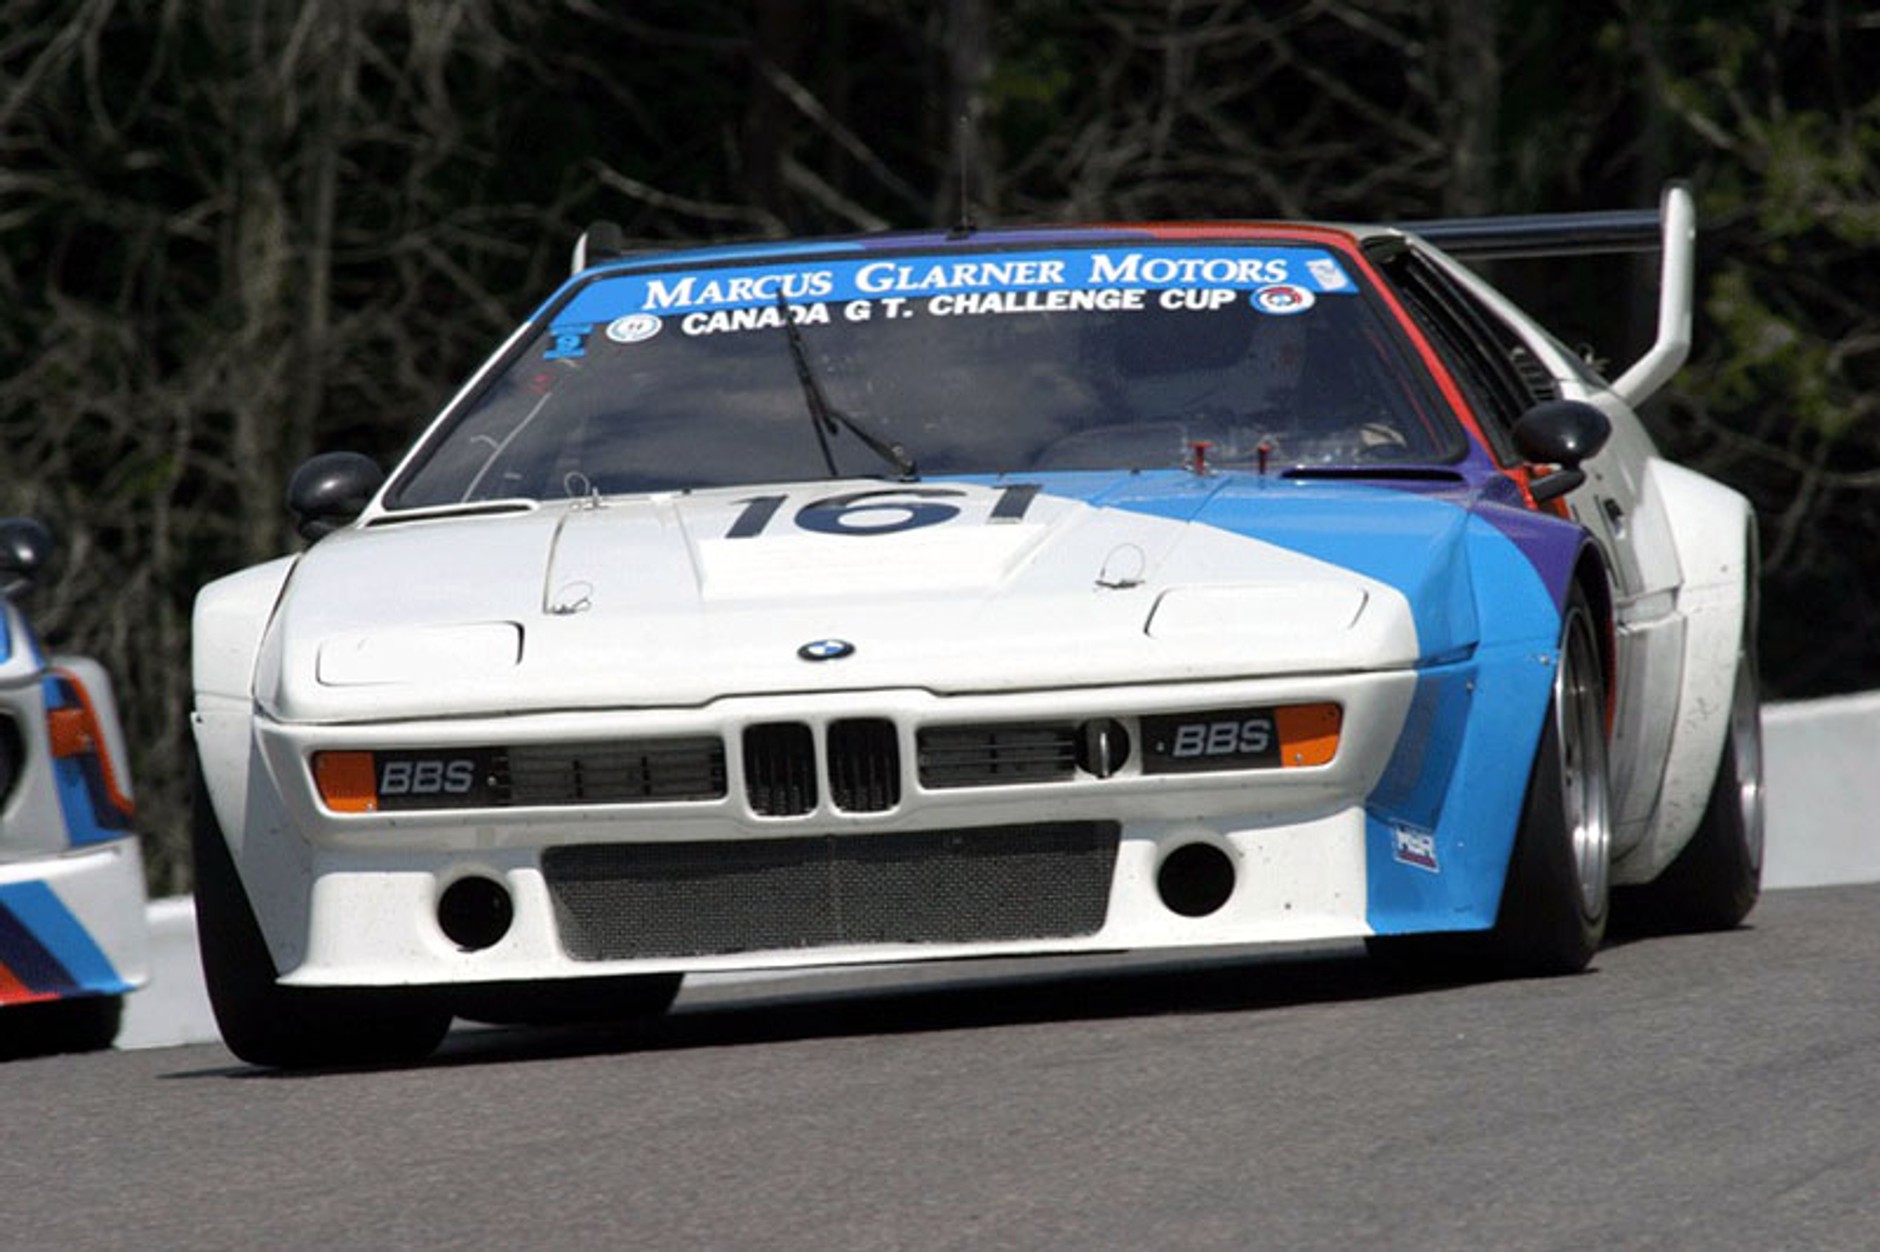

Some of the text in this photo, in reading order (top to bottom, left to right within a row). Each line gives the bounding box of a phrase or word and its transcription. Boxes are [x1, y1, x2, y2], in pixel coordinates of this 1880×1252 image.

[642, 270, 833, 309] MARCUS
[855, 260, 1066, 293] GLARNER
[1090, 253, 1288, 283] MOTORS
[928, 288, 1146, 316] CHALLENGE
[1159, 288, 1237, 311] CUP
[725, 483, 1043, 538] 161
[1172, 719, 1271, 757] BBS
[380, 760, 475, 794] BBS
